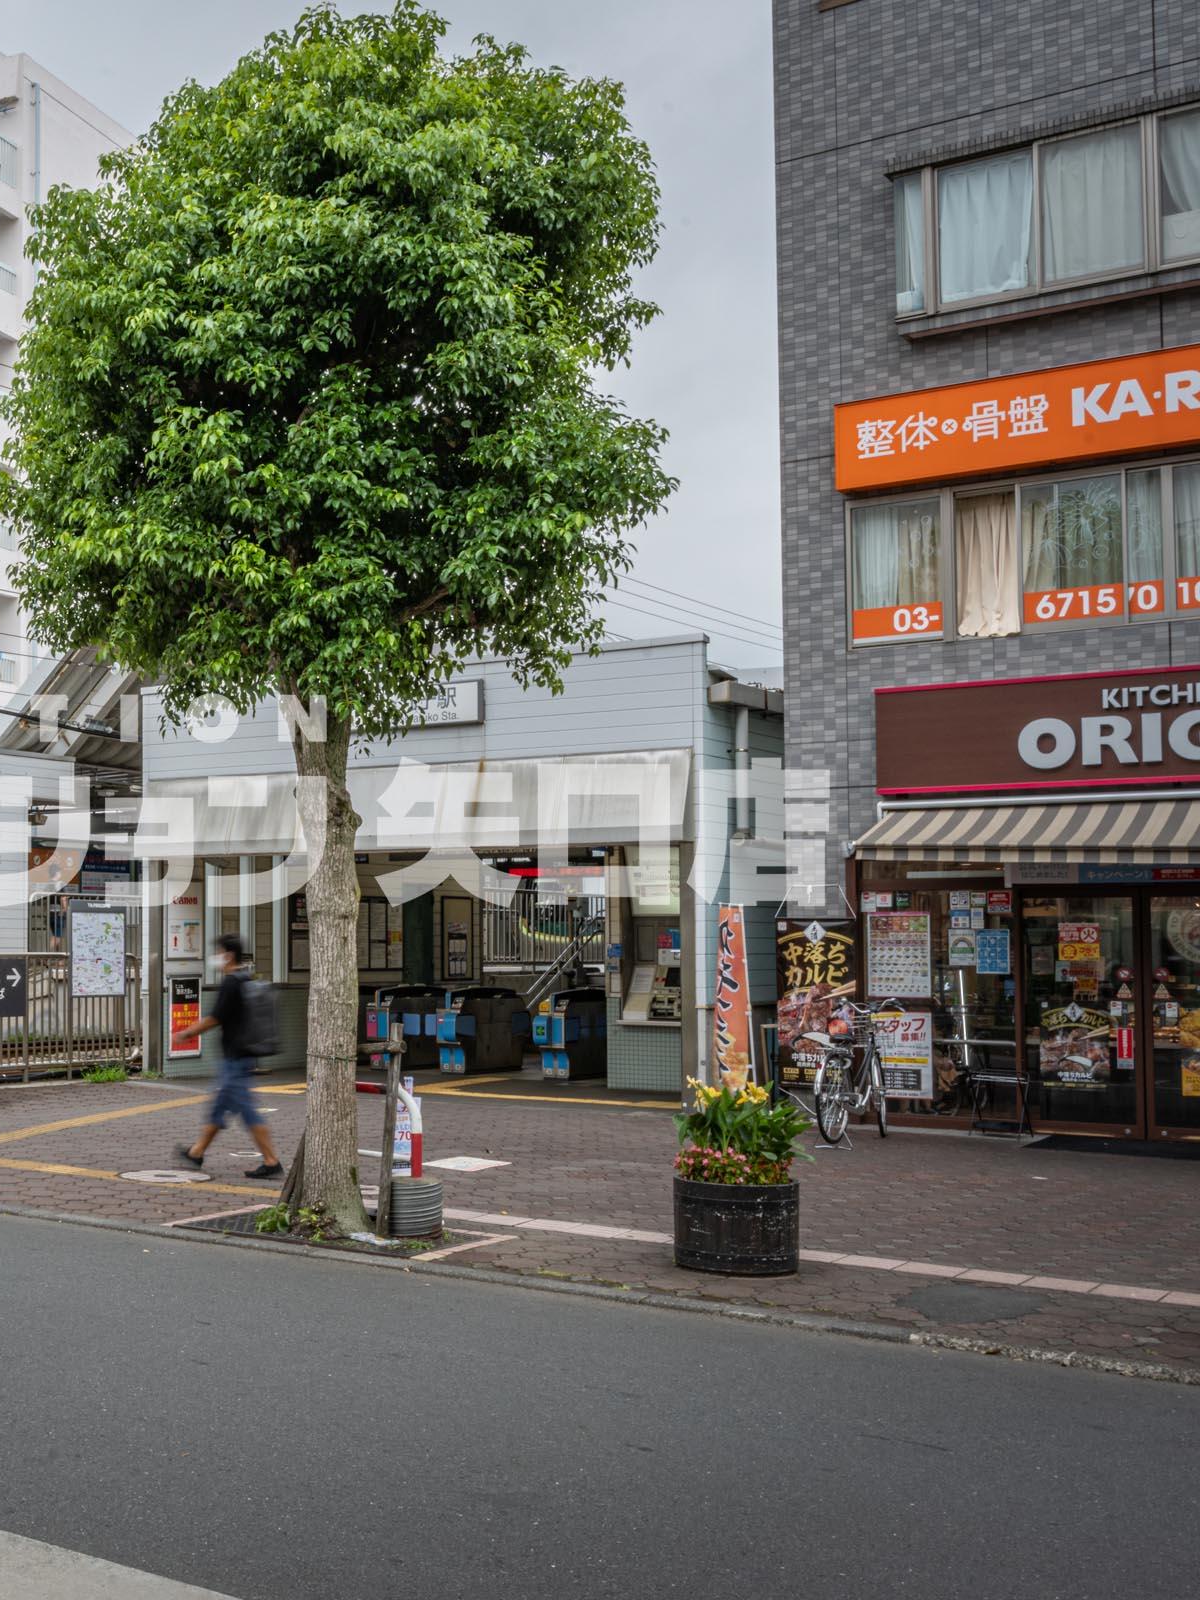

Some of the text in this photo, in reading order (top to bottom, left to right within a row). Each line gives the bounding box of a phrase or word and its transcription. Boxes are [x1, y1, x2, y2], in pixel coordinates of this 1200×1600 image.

[1035, 588, 1117, 620] 6715
[1102, 682, 1200, 709] KITCH
[172, 895, 198, 905] Canon
[782, 940, 847, 966] 中落ち
[784, 963, 850, 988] カルビ
[875, 1017, 926, 1035] スタッフ
[791, 1052, 825, 1062] 中落ちカル
